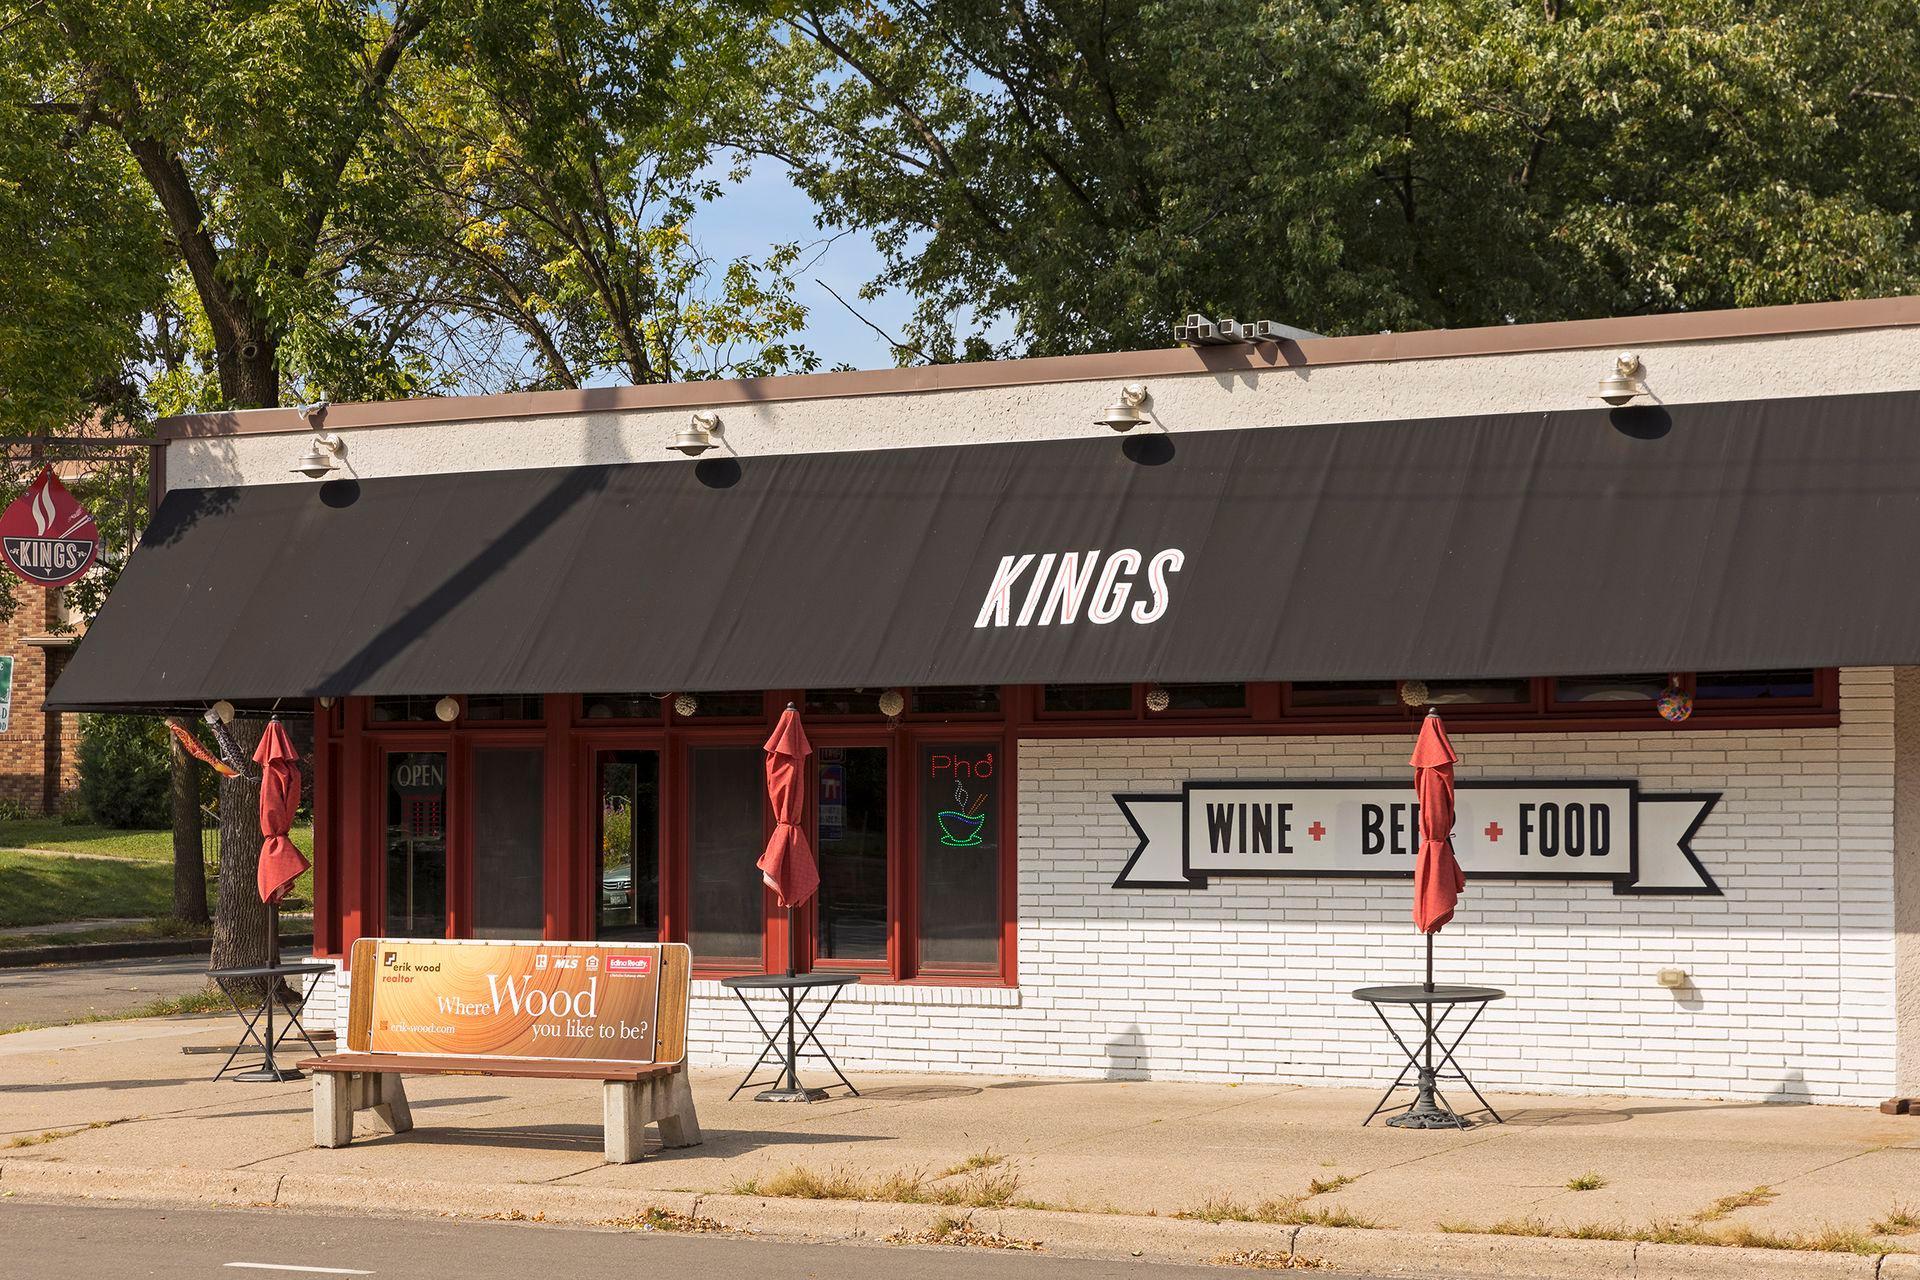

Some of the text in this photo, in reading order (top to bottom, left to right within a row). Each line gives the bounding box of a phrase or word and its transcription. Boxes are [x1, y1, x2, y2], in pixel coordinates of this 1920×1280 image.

[20, 541, 77, 569] KINGS
[974, 548, 1185, 628] KINGS
[397, 764, 443, 787] OPEN
[1206, 803, 1294, 854] WINE
[1519, 802, 1610, 857] FOOD
[393, 962, 441, 972] erik wood
[554, 959, 579, 969] MLS
[382, 973, 415, 983] realtor
[437, 974, 597, 1018] Where Wood
[531, 1019, 648, 1042] you like to be?
